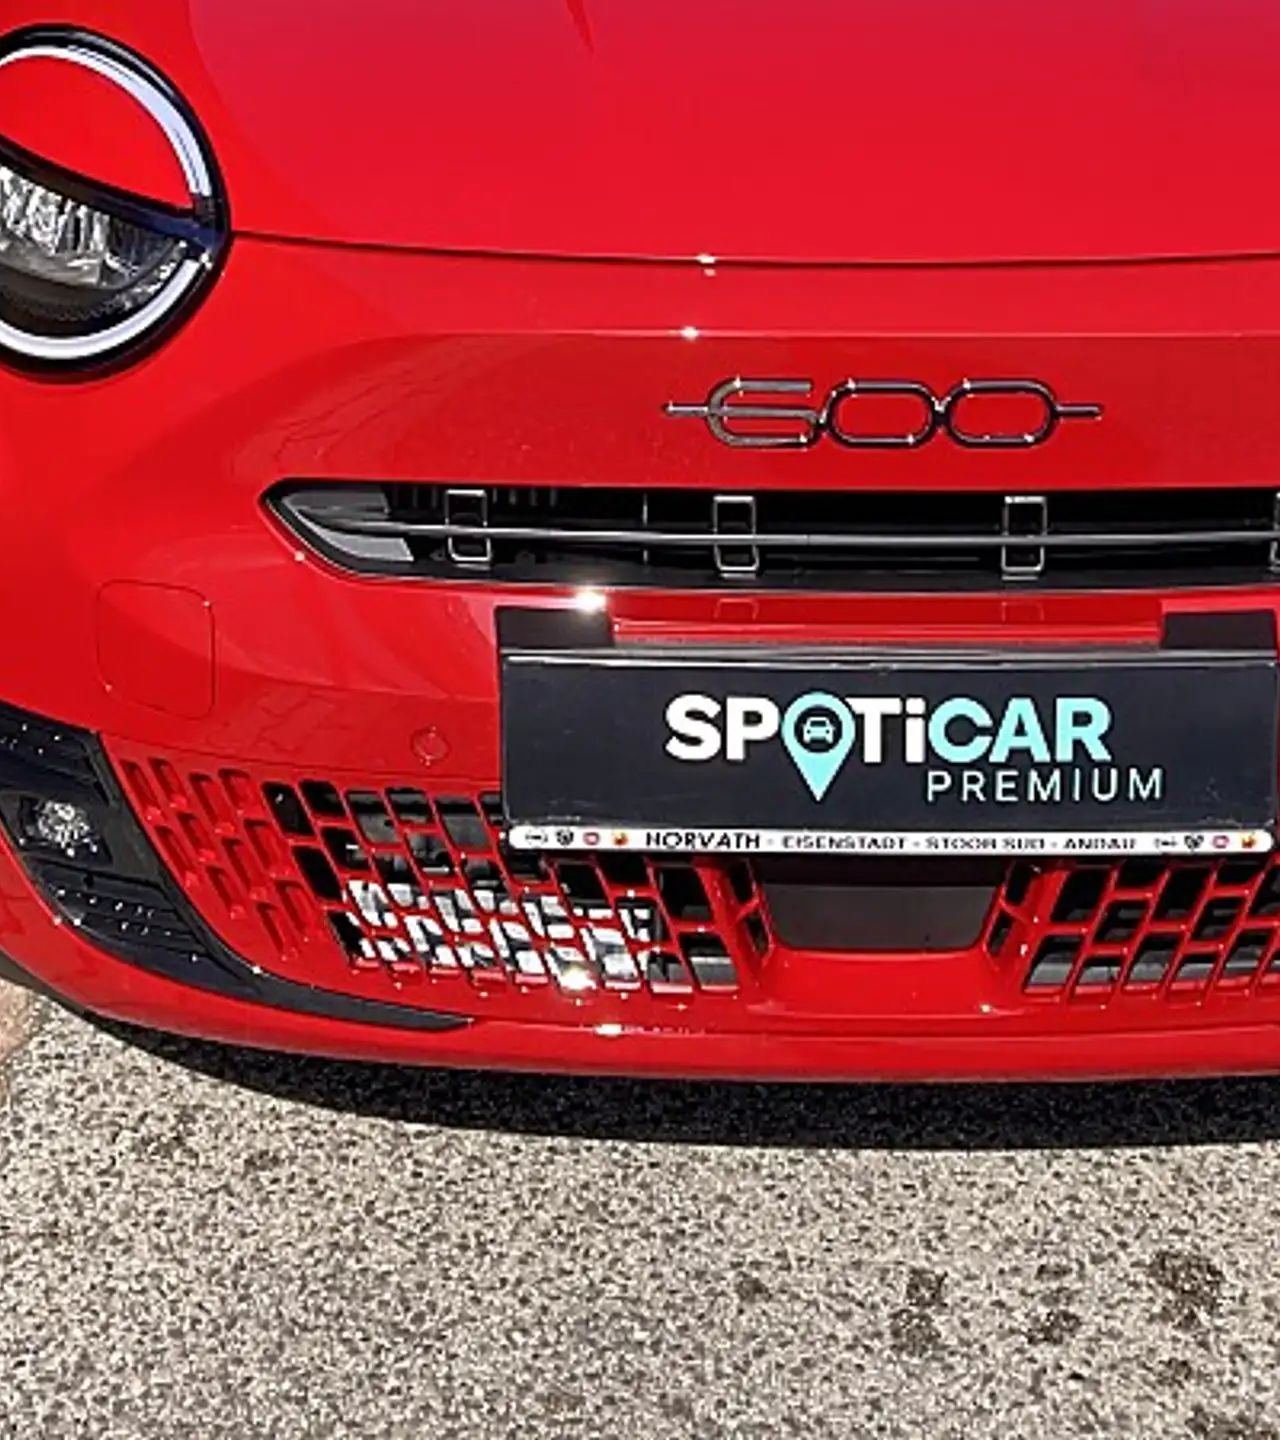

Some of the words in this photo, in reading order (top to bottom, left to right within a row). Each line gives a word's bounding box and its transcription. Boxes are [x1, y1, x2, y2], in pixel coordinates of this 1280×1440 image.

[661, 377, 1107, 449] 600
[925, 766, 1164, 804] PREMIUM
[646, 831, 760, 850] HORVATH
